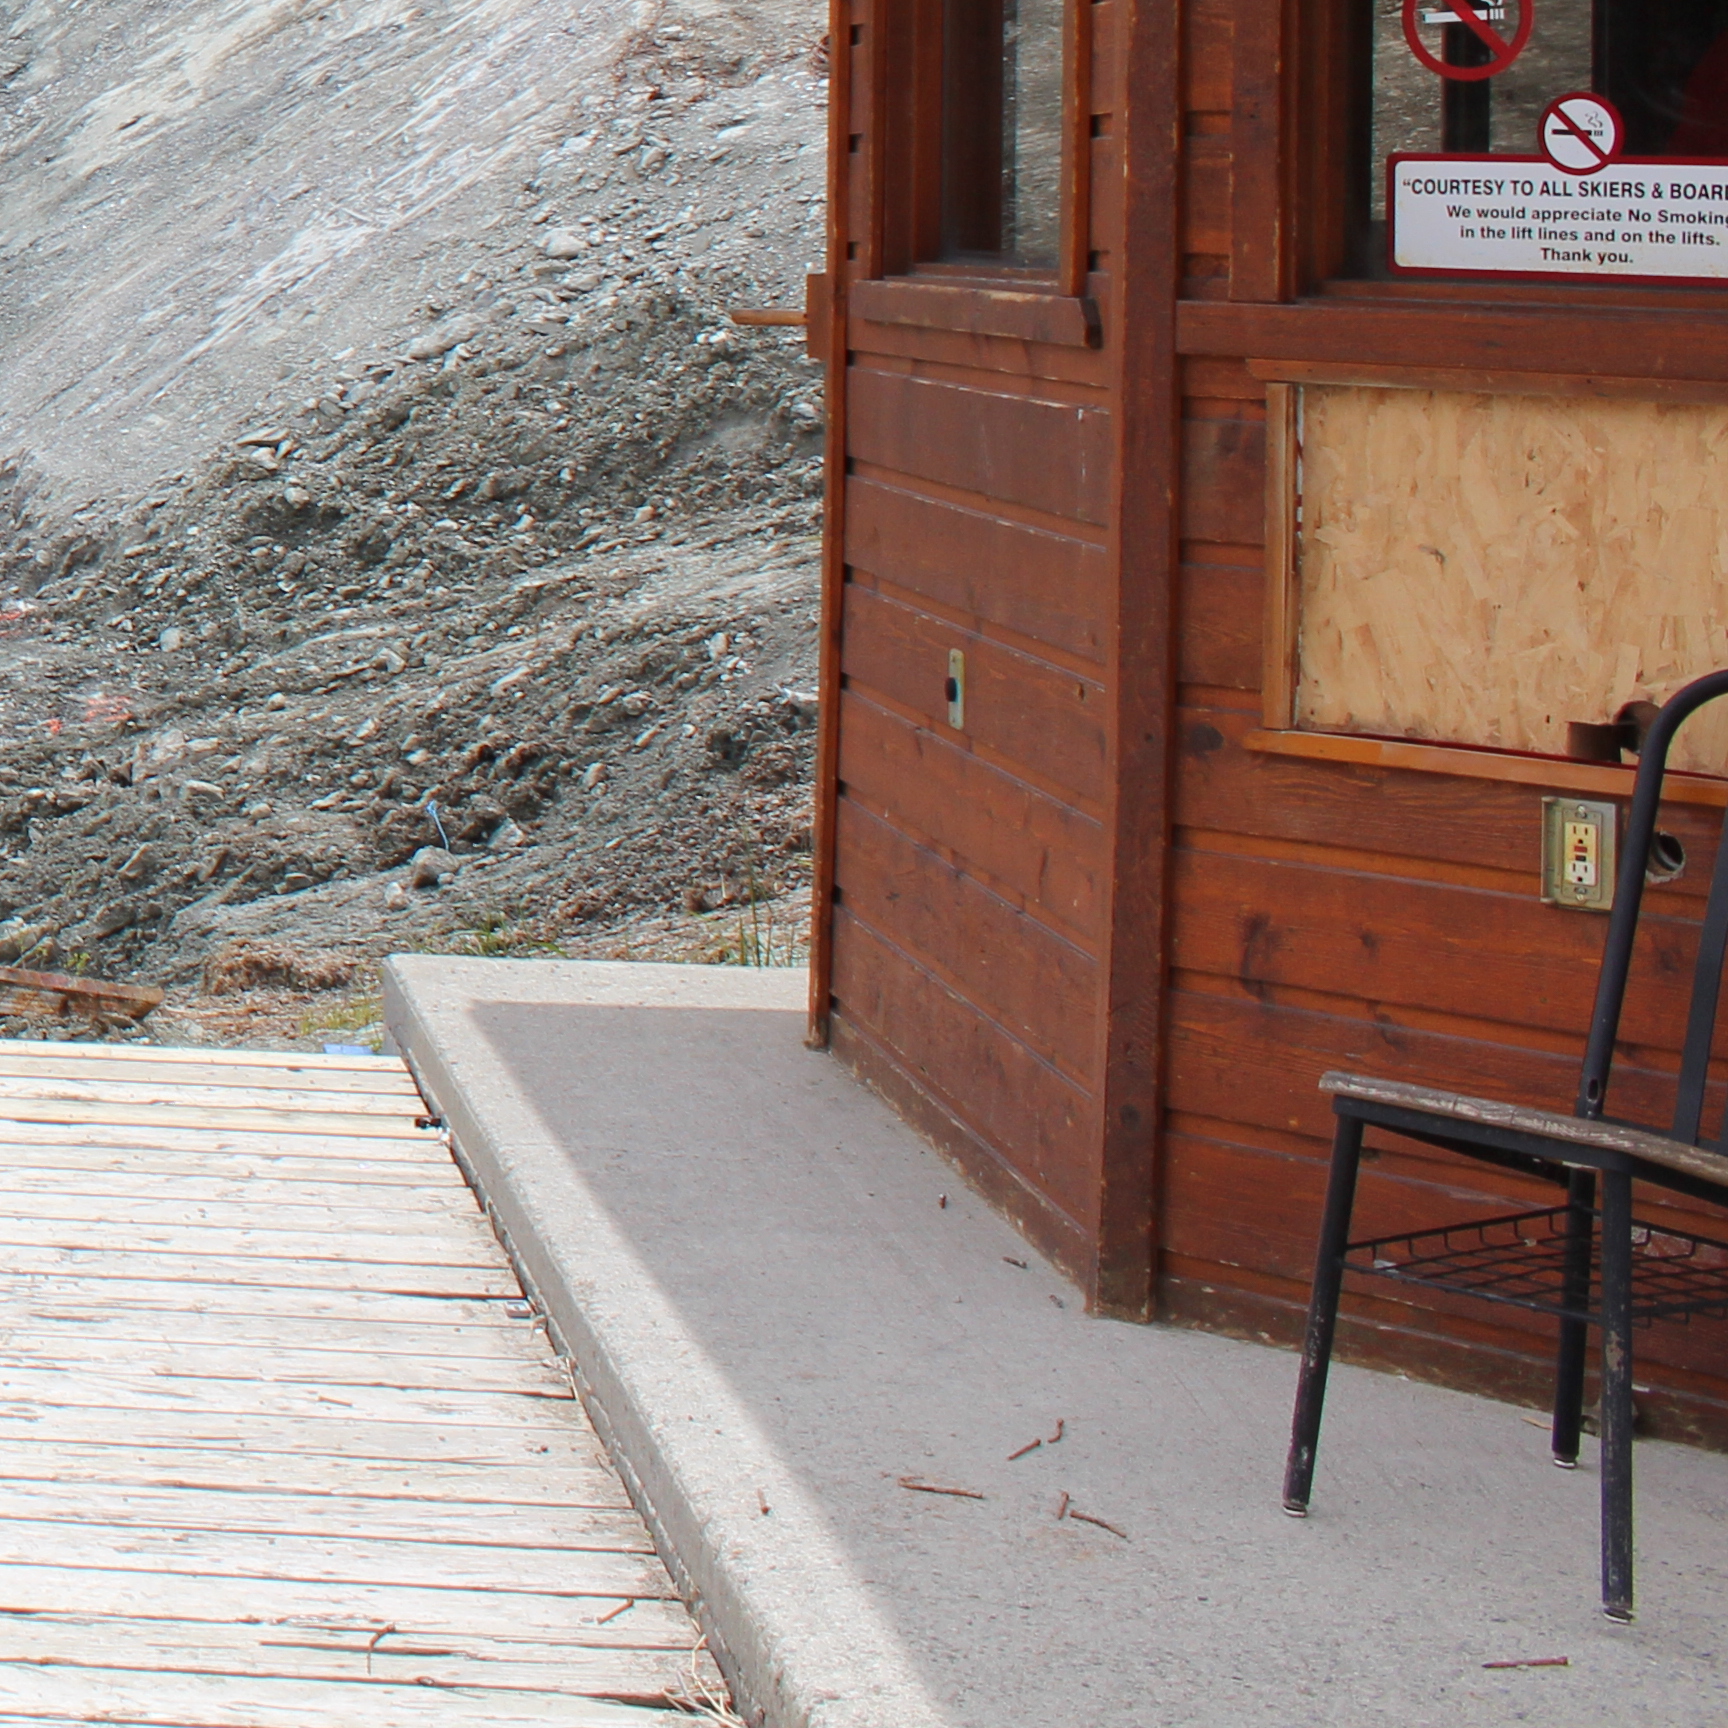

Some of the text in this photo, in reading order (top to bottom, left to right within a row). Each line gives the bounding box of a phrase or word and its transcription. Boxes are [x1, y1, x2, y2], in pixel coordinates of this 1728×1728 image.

[1510, 179, 1534, 196] TO
[1539, 180, 1573, 197] ALL
[1578, 180, 1646, 199] SKIERS
[1651, 182, 1663, 199] &
[1446, 205, 1471, 218] We
[1476, 206, 1526, 219] would
[1531, 207, 1622, 223] appreciate
[1628, 208, 1652, 223] No
[1460, 225, 1721, 246] in the lift lines and on the lifts.
[1540, 247, 1634, 266] Thank you.
